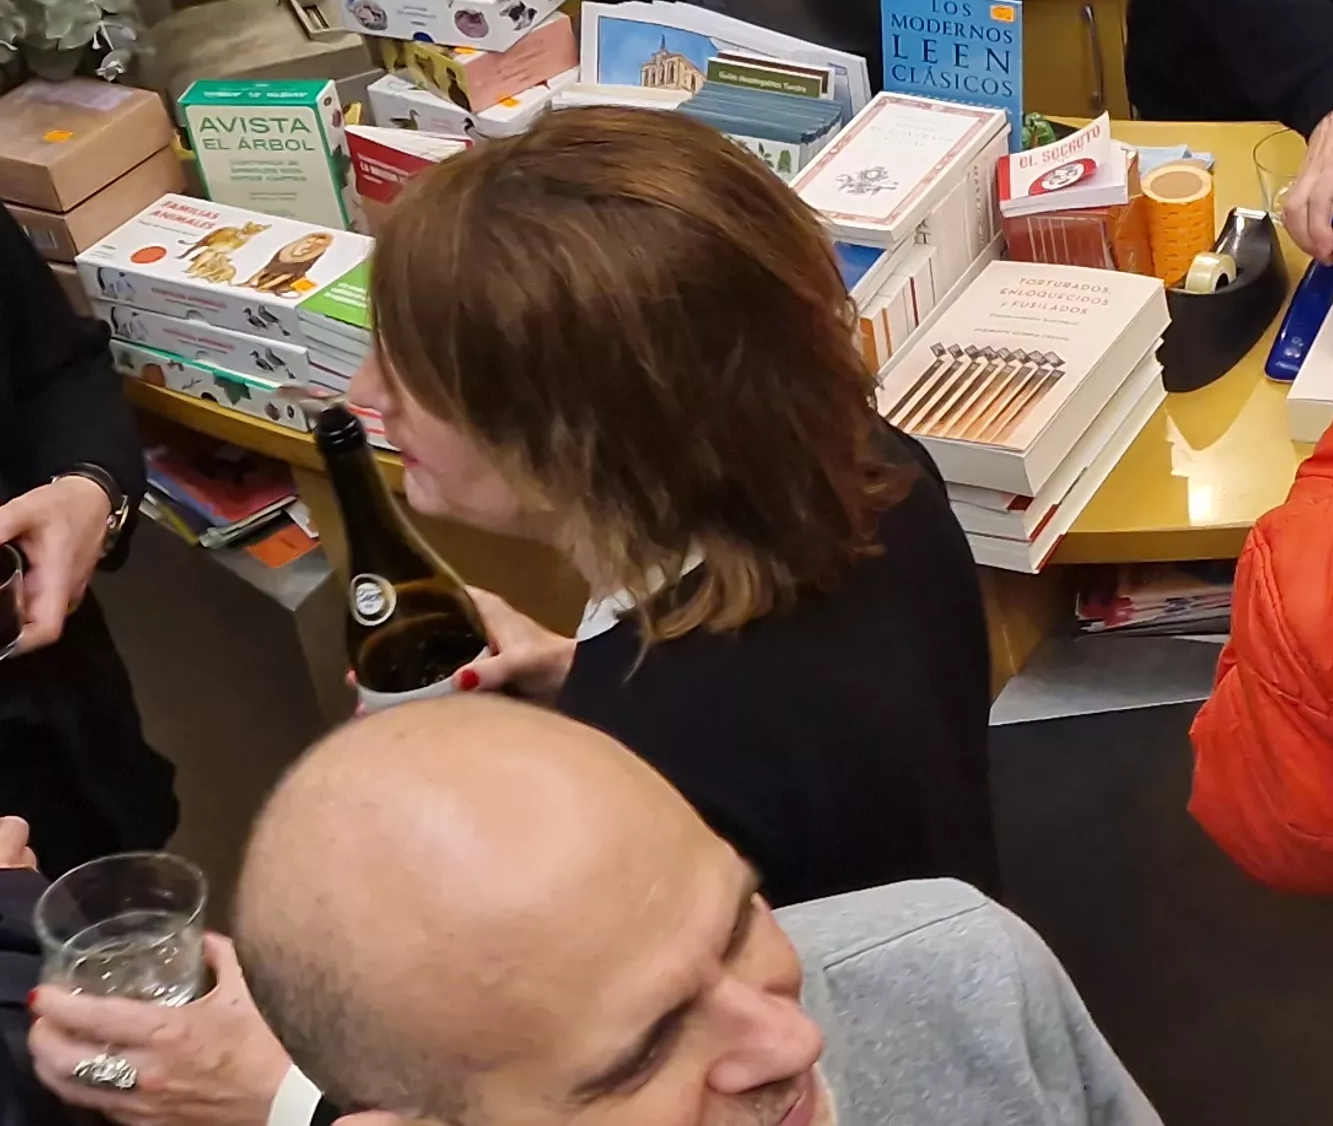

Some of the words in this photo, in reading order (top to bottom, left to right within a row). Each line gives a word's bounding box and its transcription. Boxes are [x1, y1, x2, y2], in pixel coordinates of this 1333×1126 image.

[890, 12, 1013, 45] MODERNOS
[892, 33, 1011, 75] LEEN
[891, 63, 1013, 98] CLÁSICOS
[200, 116, 312, 134] AVISTA
[202, 138, 231, 151] EL
[237, 136, 316, 152] ÁRBOL
[148, 209, 216, 231] ANIMALES
[161, 200, 221, 221] FAMILIAS
[999, 287, 1110, 306] ENLOQUECIDOS
[1011, 300, 1089, 316] FUSILADOS
